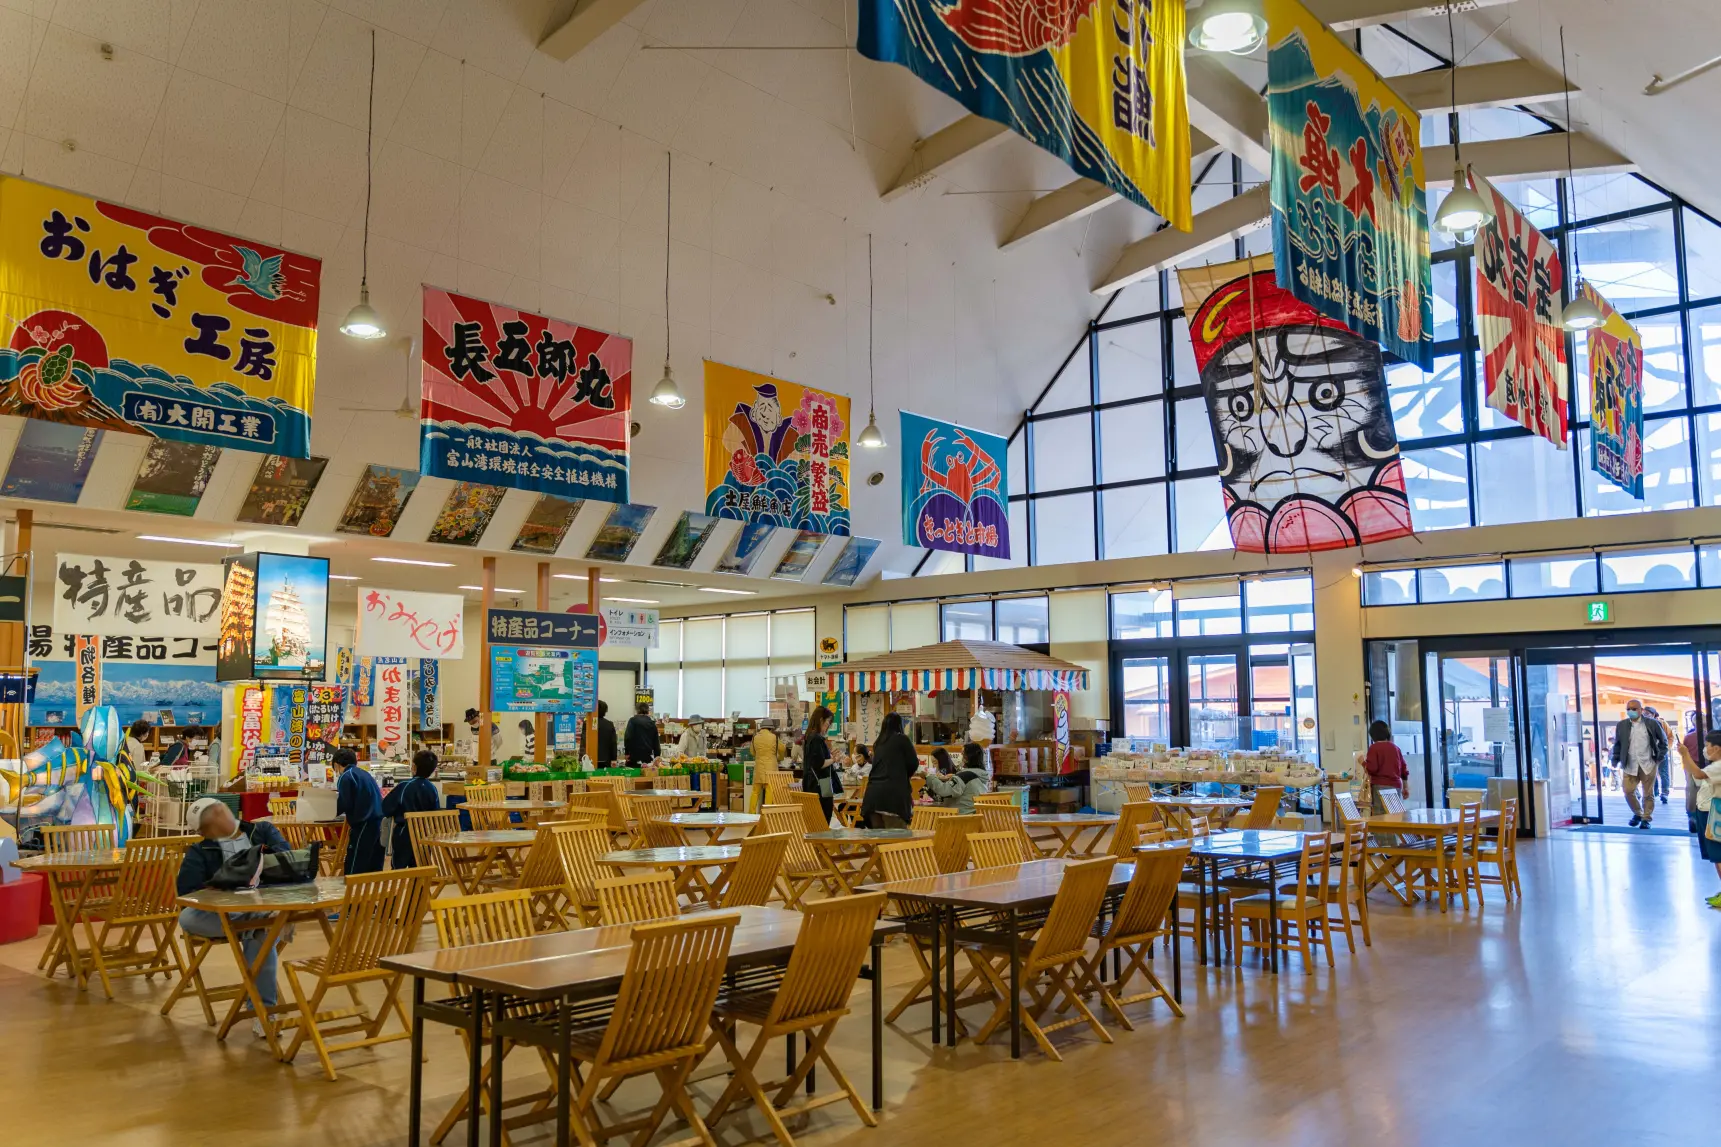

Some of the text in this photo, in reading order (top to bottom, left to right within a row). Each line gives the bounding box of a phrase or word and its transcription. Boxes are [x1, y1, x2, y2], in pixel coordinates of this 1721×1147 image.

[40, 210, 278, 382] おはぎ工房
[444, 320, 616, 410] 長五郎丸
[454, 435, 533, 458] 一般社団法人
[811, 404, 829, 513] 商売繁盛
[446, 450, 618, 489] 富山湾環境保全安全推進機構
[724, 490, 793, 517] 土屋鮮魚店
[923, 514, 999, 547] きっときと市場
[57, 558, 222, 625] 特産品
[365, 590, 461, 656] おみやげ
[491, 615, 597, 641] 特産品コーナー
[64, 634, 219, 661] 産品コー
[807, 676, 826, 685] お会計
[309, 704, 339, 714] ほたるいか
[289, 689, 306, 766] 富山湾の三
[307, 729, 322, 739] VS
[306, 741, 325, 749] いか
